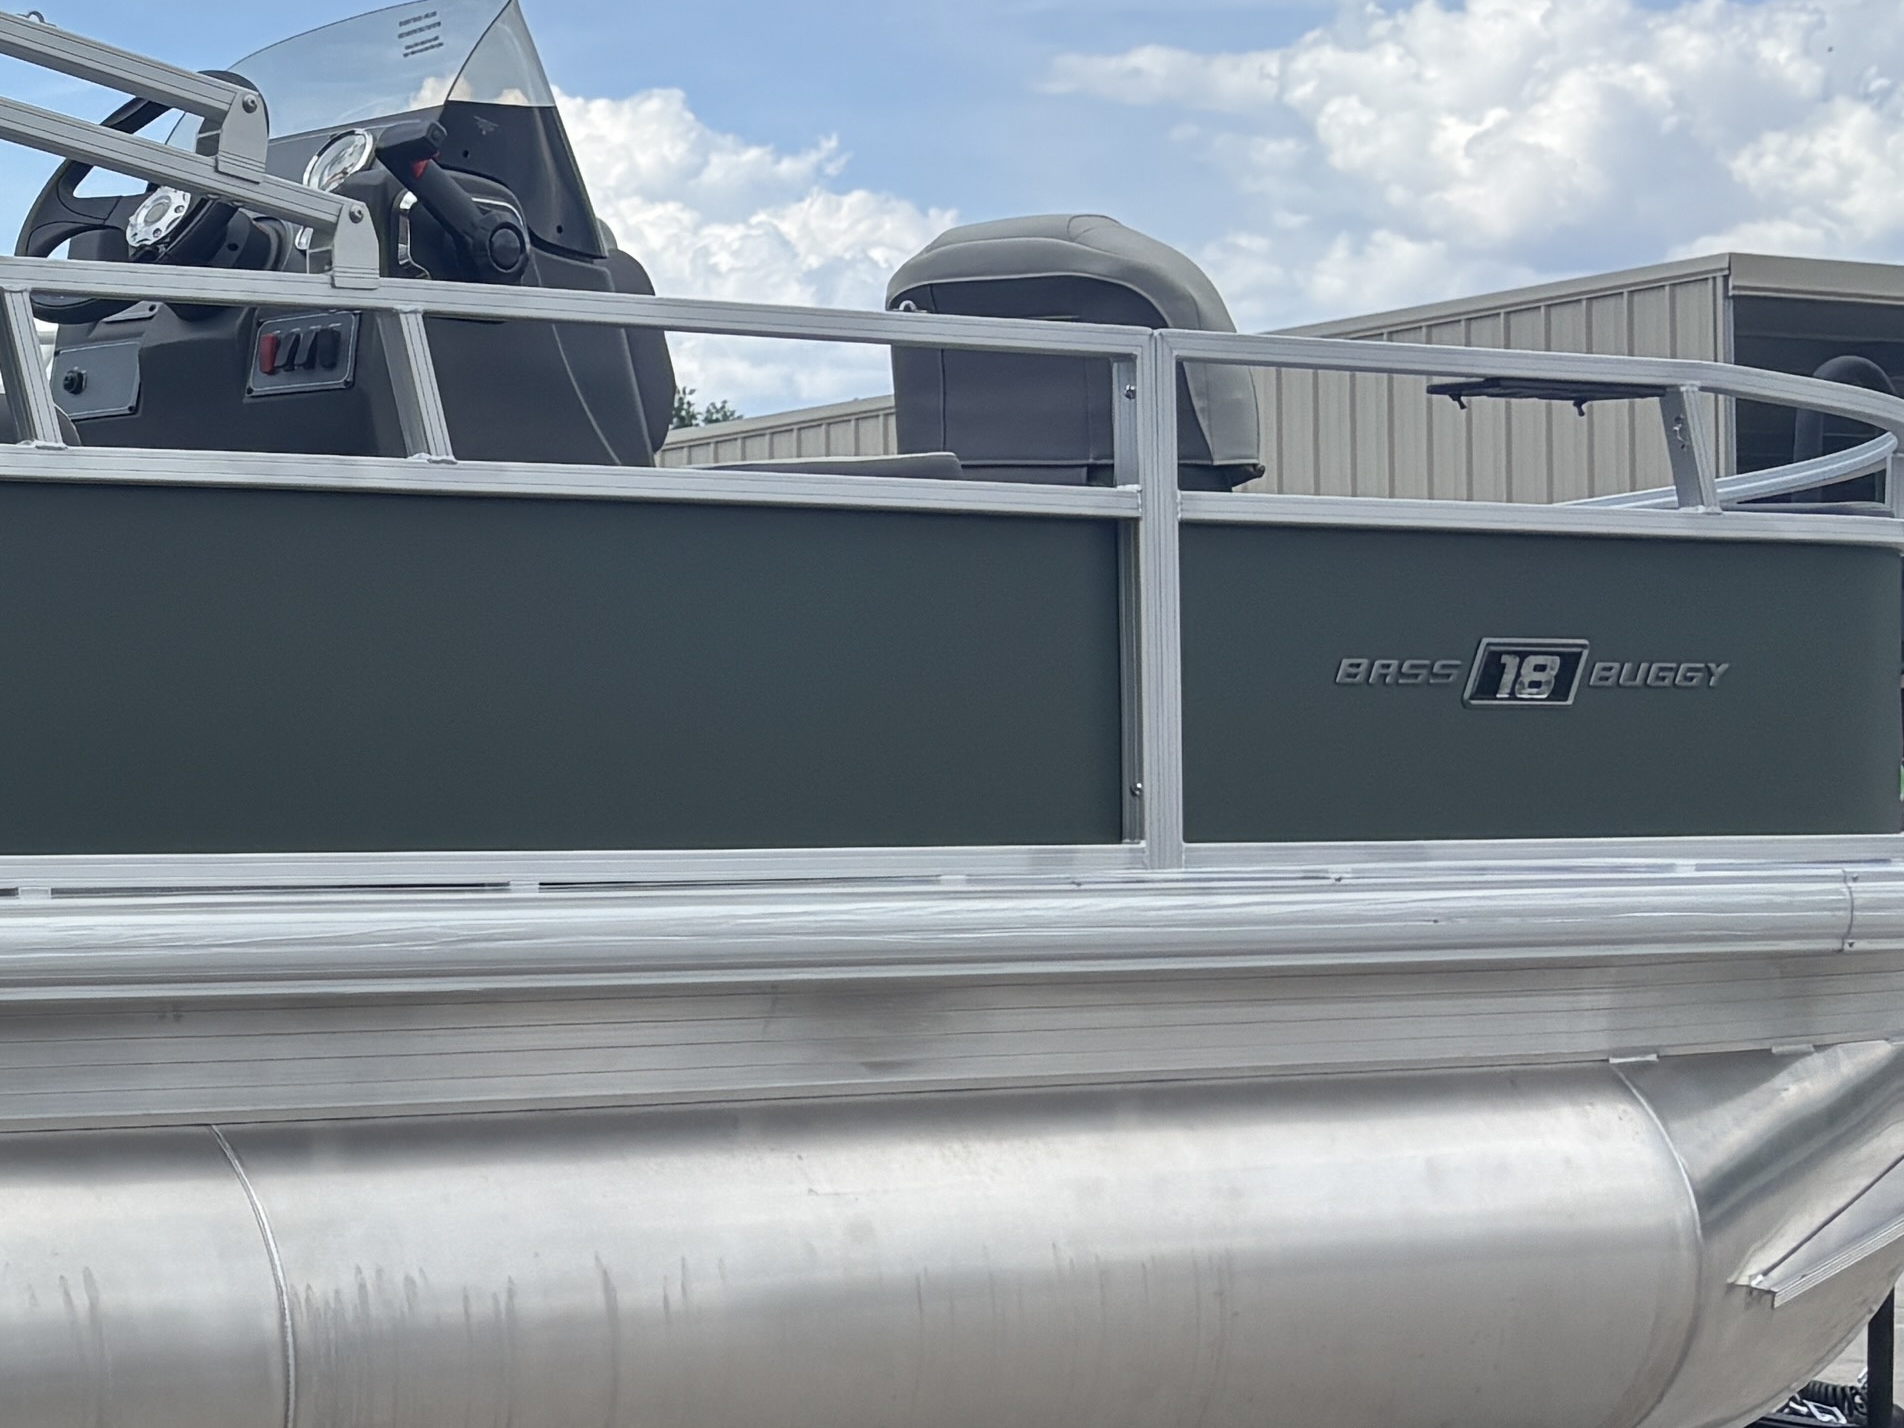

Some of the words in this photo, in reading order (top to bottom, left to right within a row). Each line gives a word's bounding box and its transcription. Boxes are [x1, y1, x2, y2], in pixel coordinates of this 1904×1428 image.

[1335, 658, 1462, 684] BASS
[1496, 655, 1561, 699] 18
[1590, 662, 1729, 688] BUGGY
